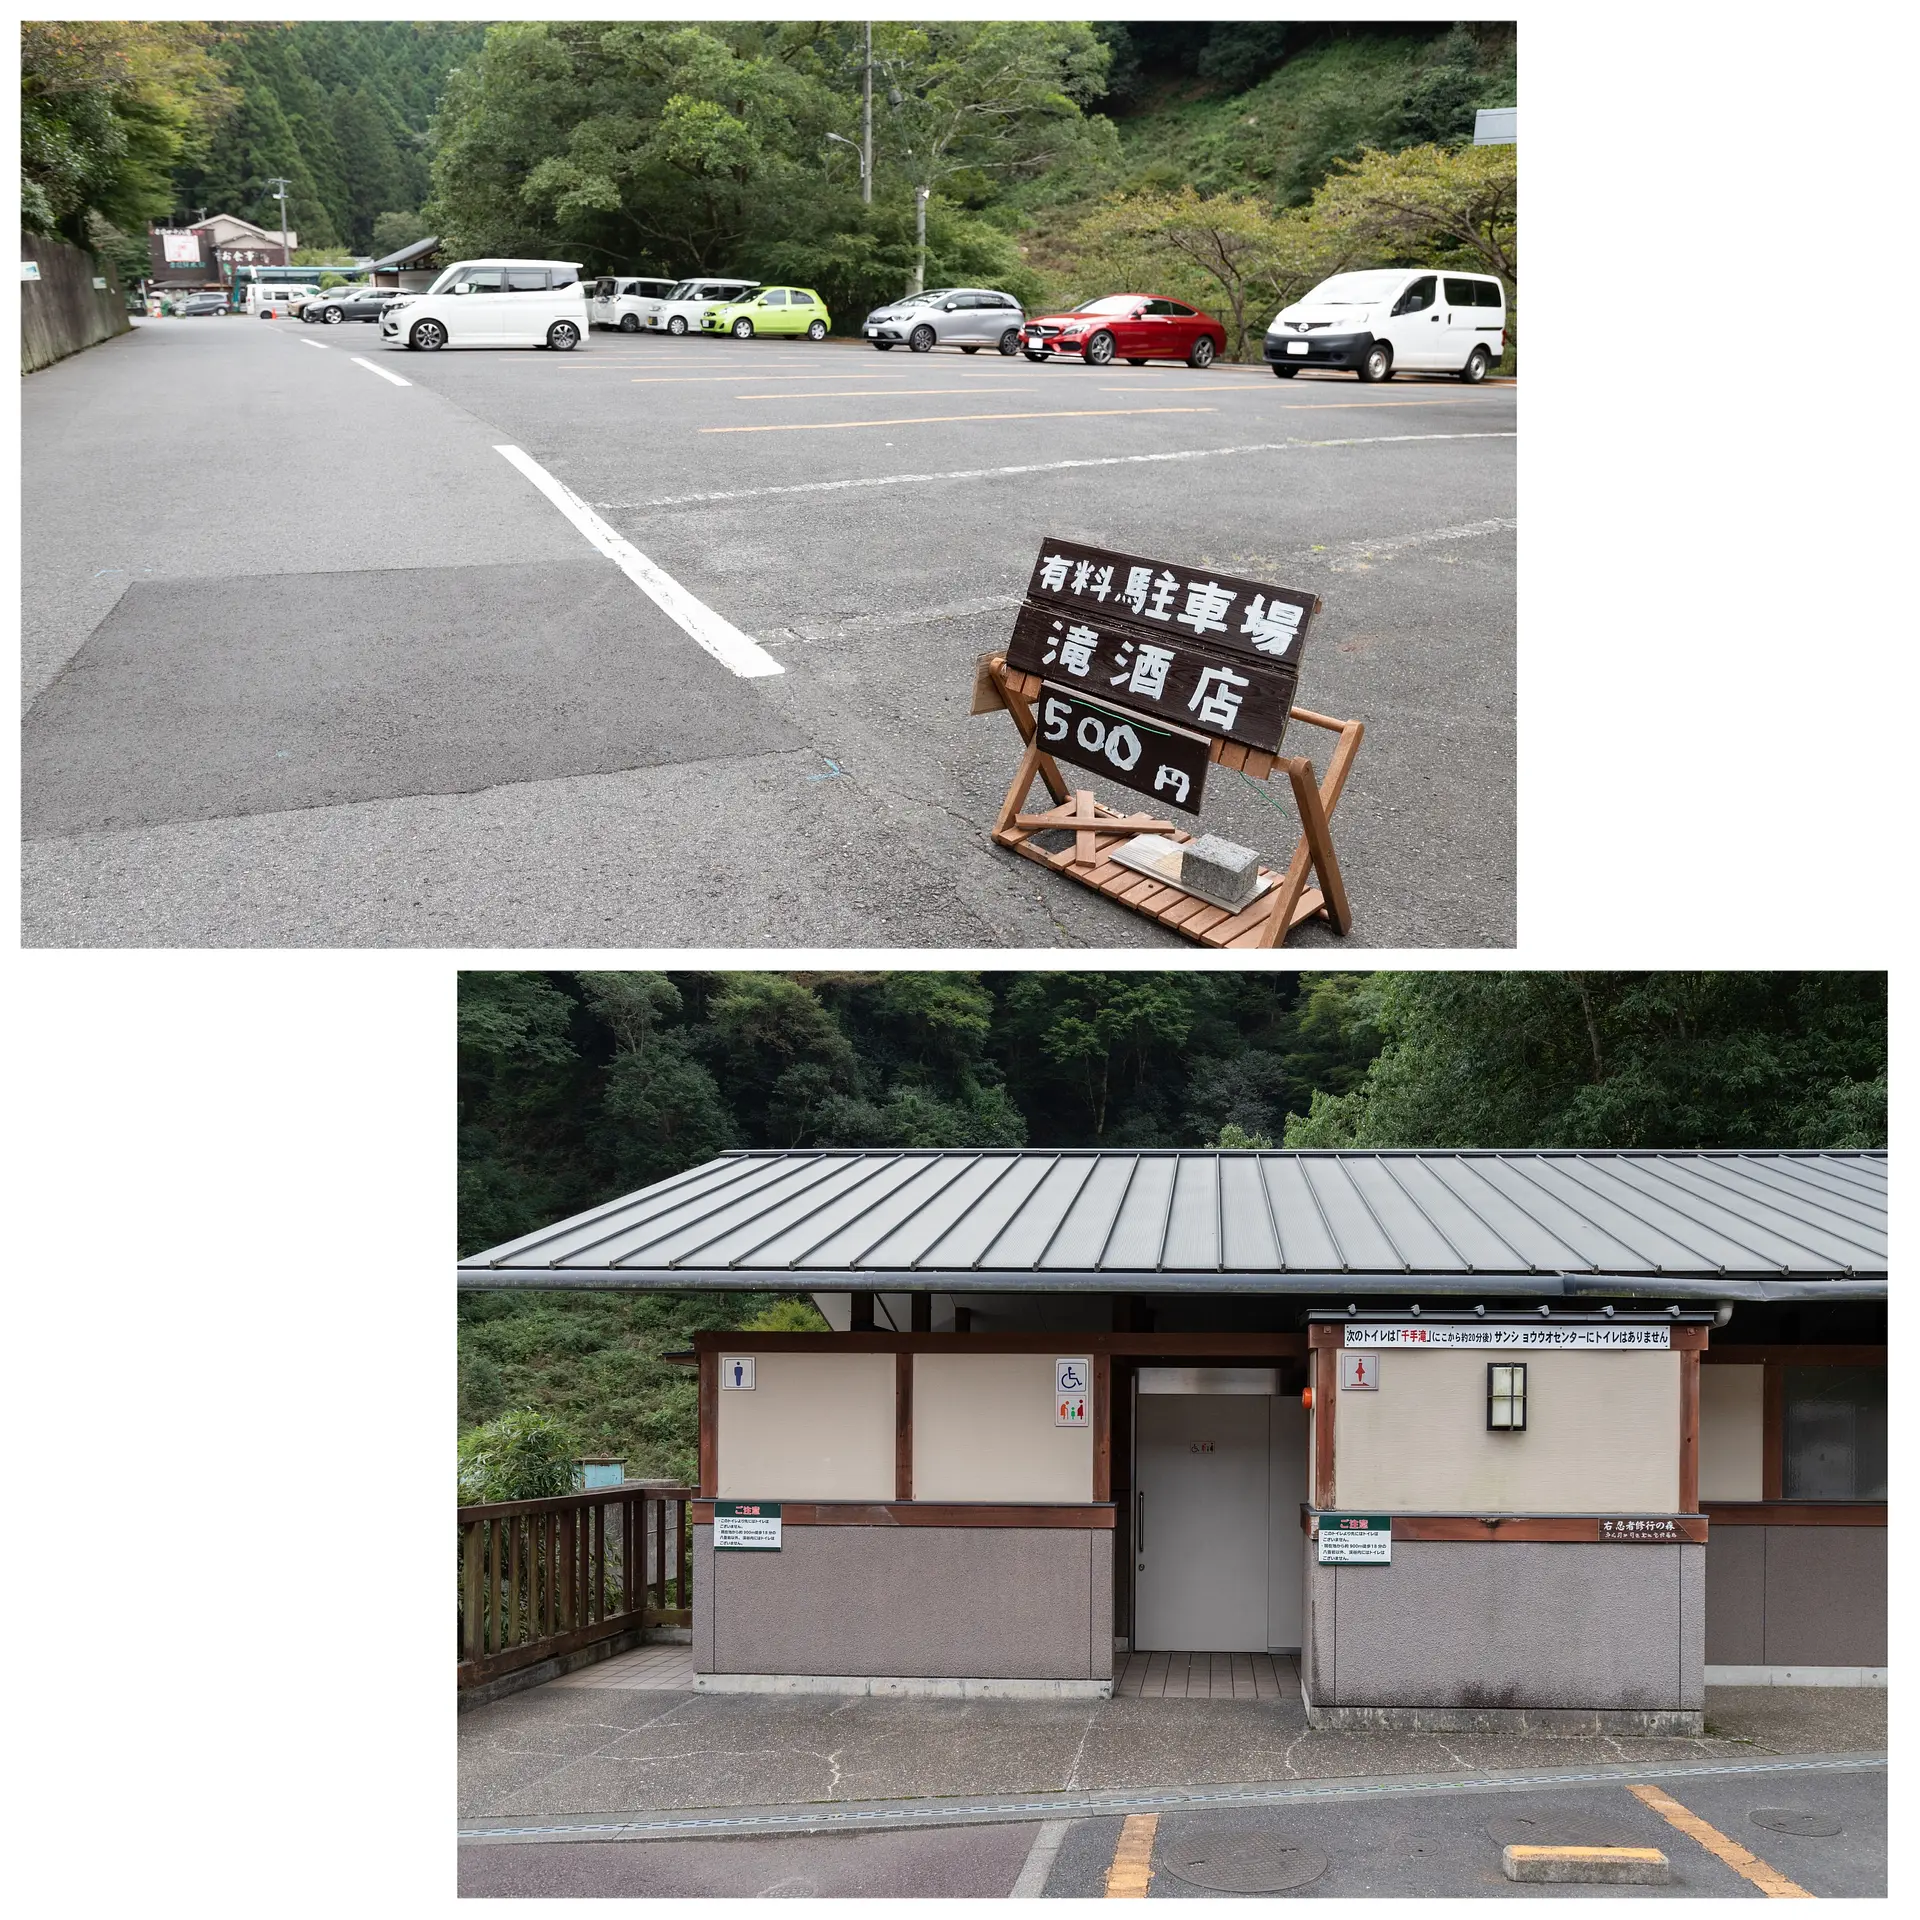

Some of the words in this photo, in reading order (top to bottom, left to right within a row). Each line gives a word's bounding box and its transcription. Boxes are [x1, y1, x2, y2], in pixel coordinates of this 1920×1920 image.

[1039, 553, 1304, 656] 有料駐車場
[1041, 620, 1250, 732] 滝酒店
[1603, 1520, 1613, 1531] 右
